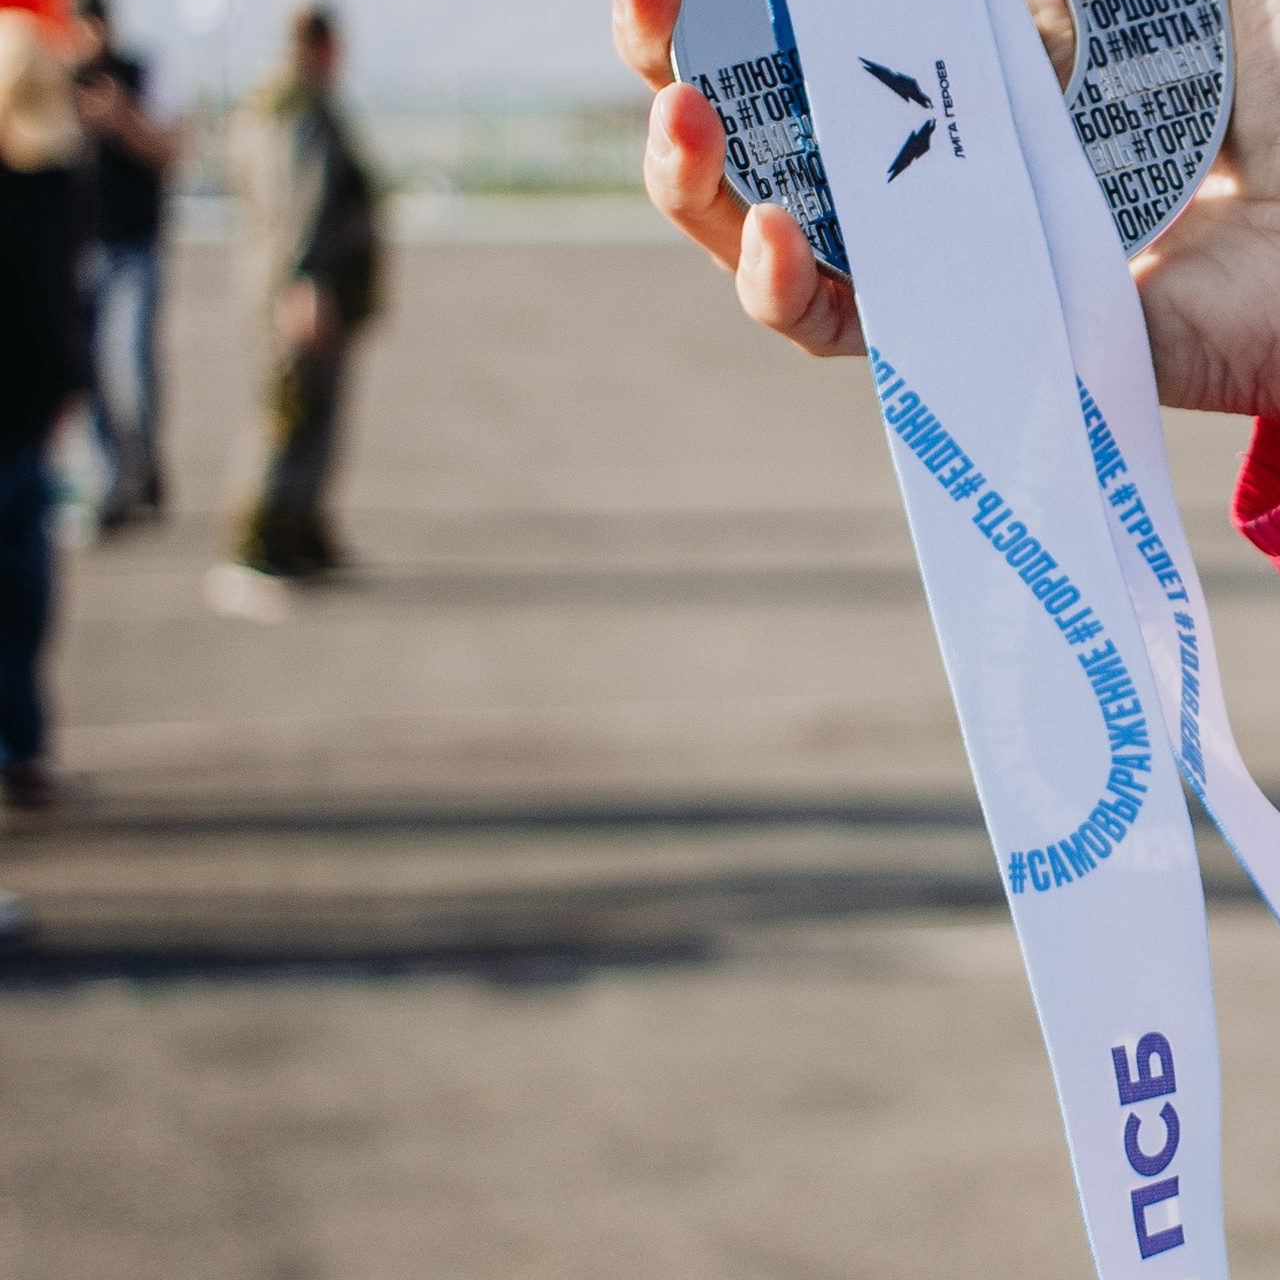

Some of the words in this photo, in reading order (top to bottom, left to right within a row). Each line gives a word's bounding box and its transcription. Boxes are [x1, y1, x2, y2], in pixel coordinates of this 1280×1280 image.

[935, 59, 956, 119] ГЕРОЕВ
[1107, 11, 1200, 63] #МЕЧТА
[947, 121, 967, 160] ЛИГА
[1099, 158, 1185, 210] НСТВО
[869, 345, 988, 503] #ЕДИНСТВ
[972, 490, 1104, 646] #ГОРДОСТЬ
[1108, 482, 1190, 603] #ТРЕПЕТ
[1008, 628, 1153, 895] #САМОВЫРАЖЕНИЕ
[1110, 1031, 1185, 1261] ПСБ
